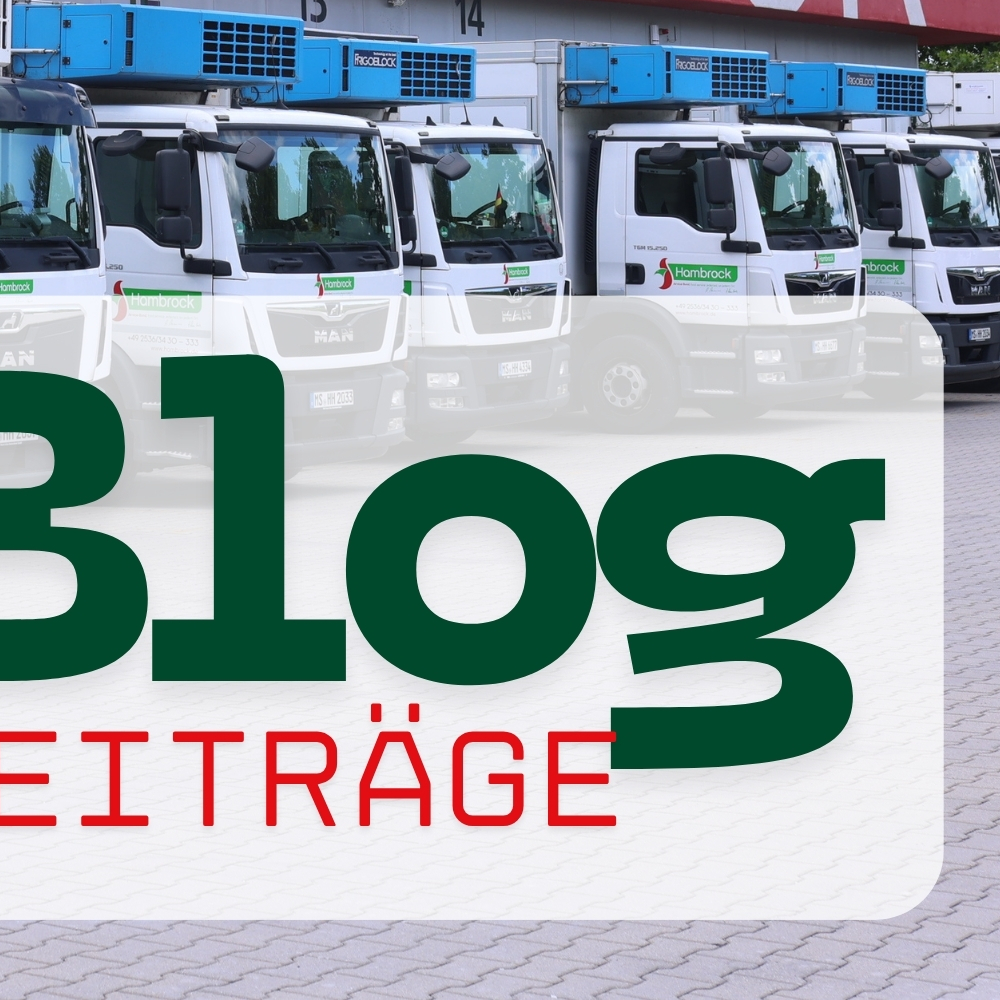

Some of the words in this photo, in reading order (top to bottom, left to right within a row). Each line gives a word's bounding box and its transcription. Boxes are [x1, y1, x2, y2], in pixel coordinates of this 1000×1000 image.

[354, 53, 397, 68] FRIGOBLOCK
[676, 58, 709, 71] FRIGOBLOCK
[846, 74, 874, 86] FRIGOBLOCK
[508, 267, 528, 276] Hambrock
[676, 266, 732, 279] Hambrock
[324, 278, 352, 288] Hambrock
[131, 292, 195, 309] Hambrock
[502, 308, 532, 322] MAN
[140, 334, 166, 344] 2536/34
[186, 338, 199, 346] 333
[314, 328, 354, 344] MAN
[314, 393, 322, 406] MS
[327, 392, 336, 405] HH
[336, 390, 353, 404] 2033
